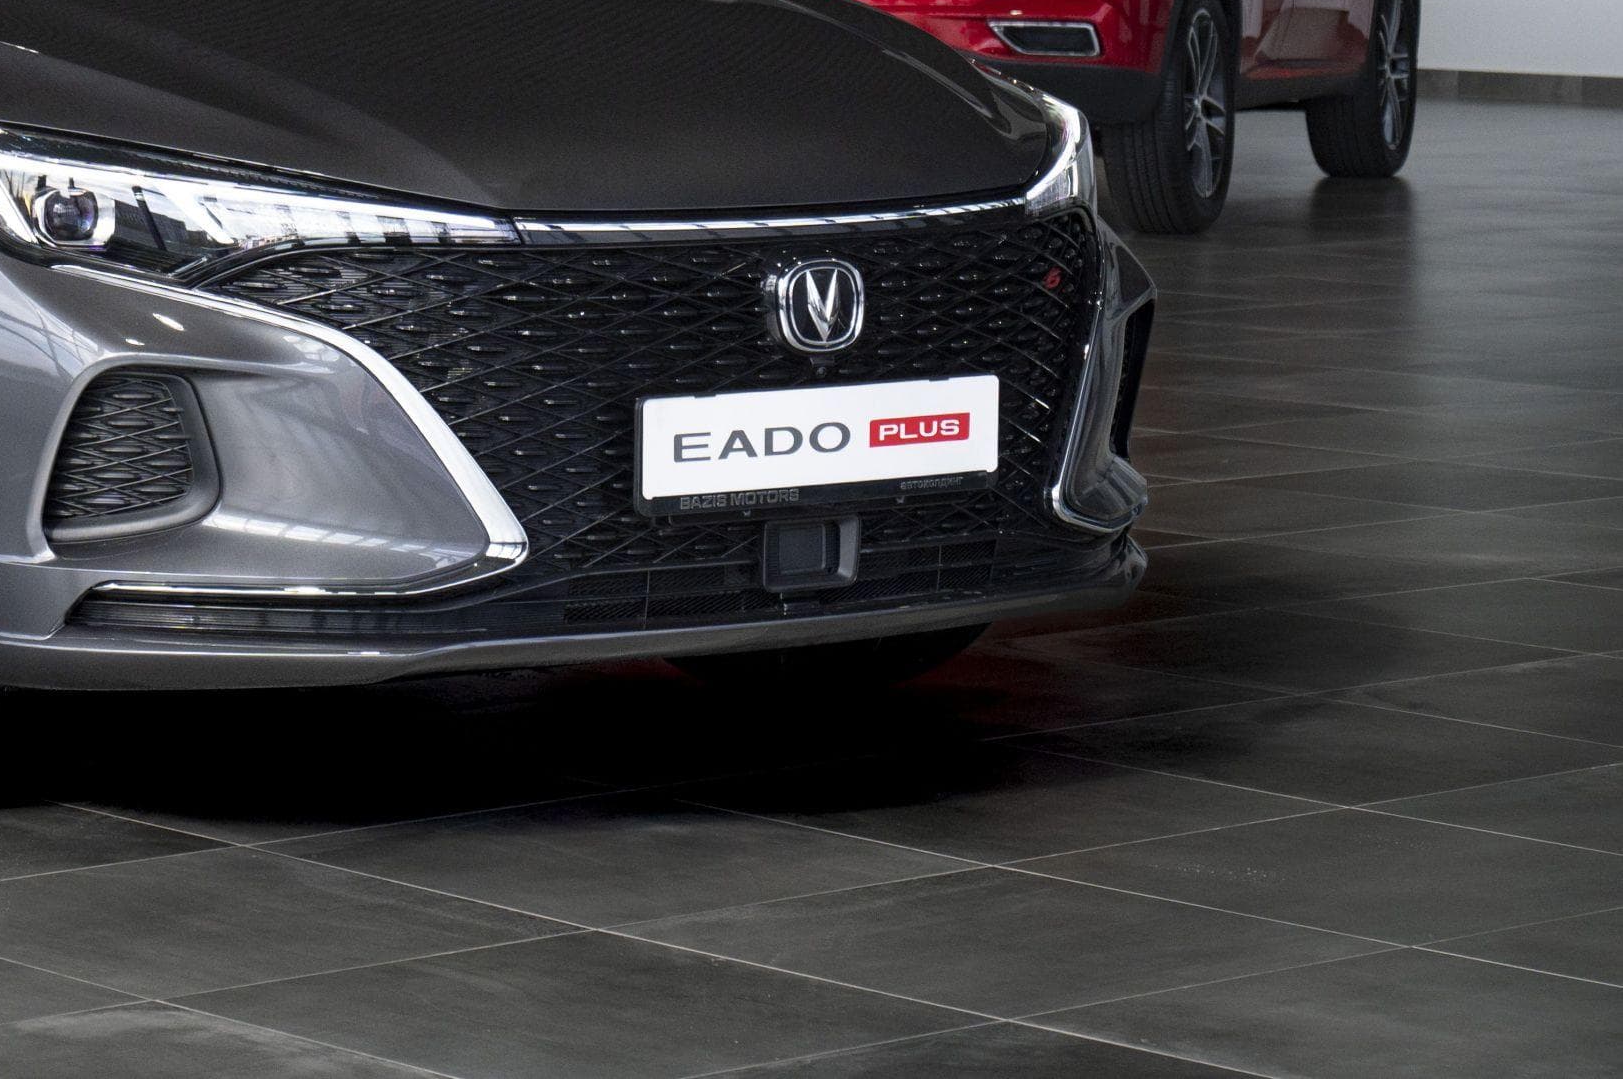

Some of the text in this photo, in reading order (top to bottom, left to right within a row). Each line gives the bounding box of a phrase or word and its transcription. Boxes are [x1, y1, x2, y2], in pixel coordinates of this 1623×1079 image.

[673, 418, 961, 463] EADO PLUS
[679, 487, 799, 511] BAZIS MOTORS
